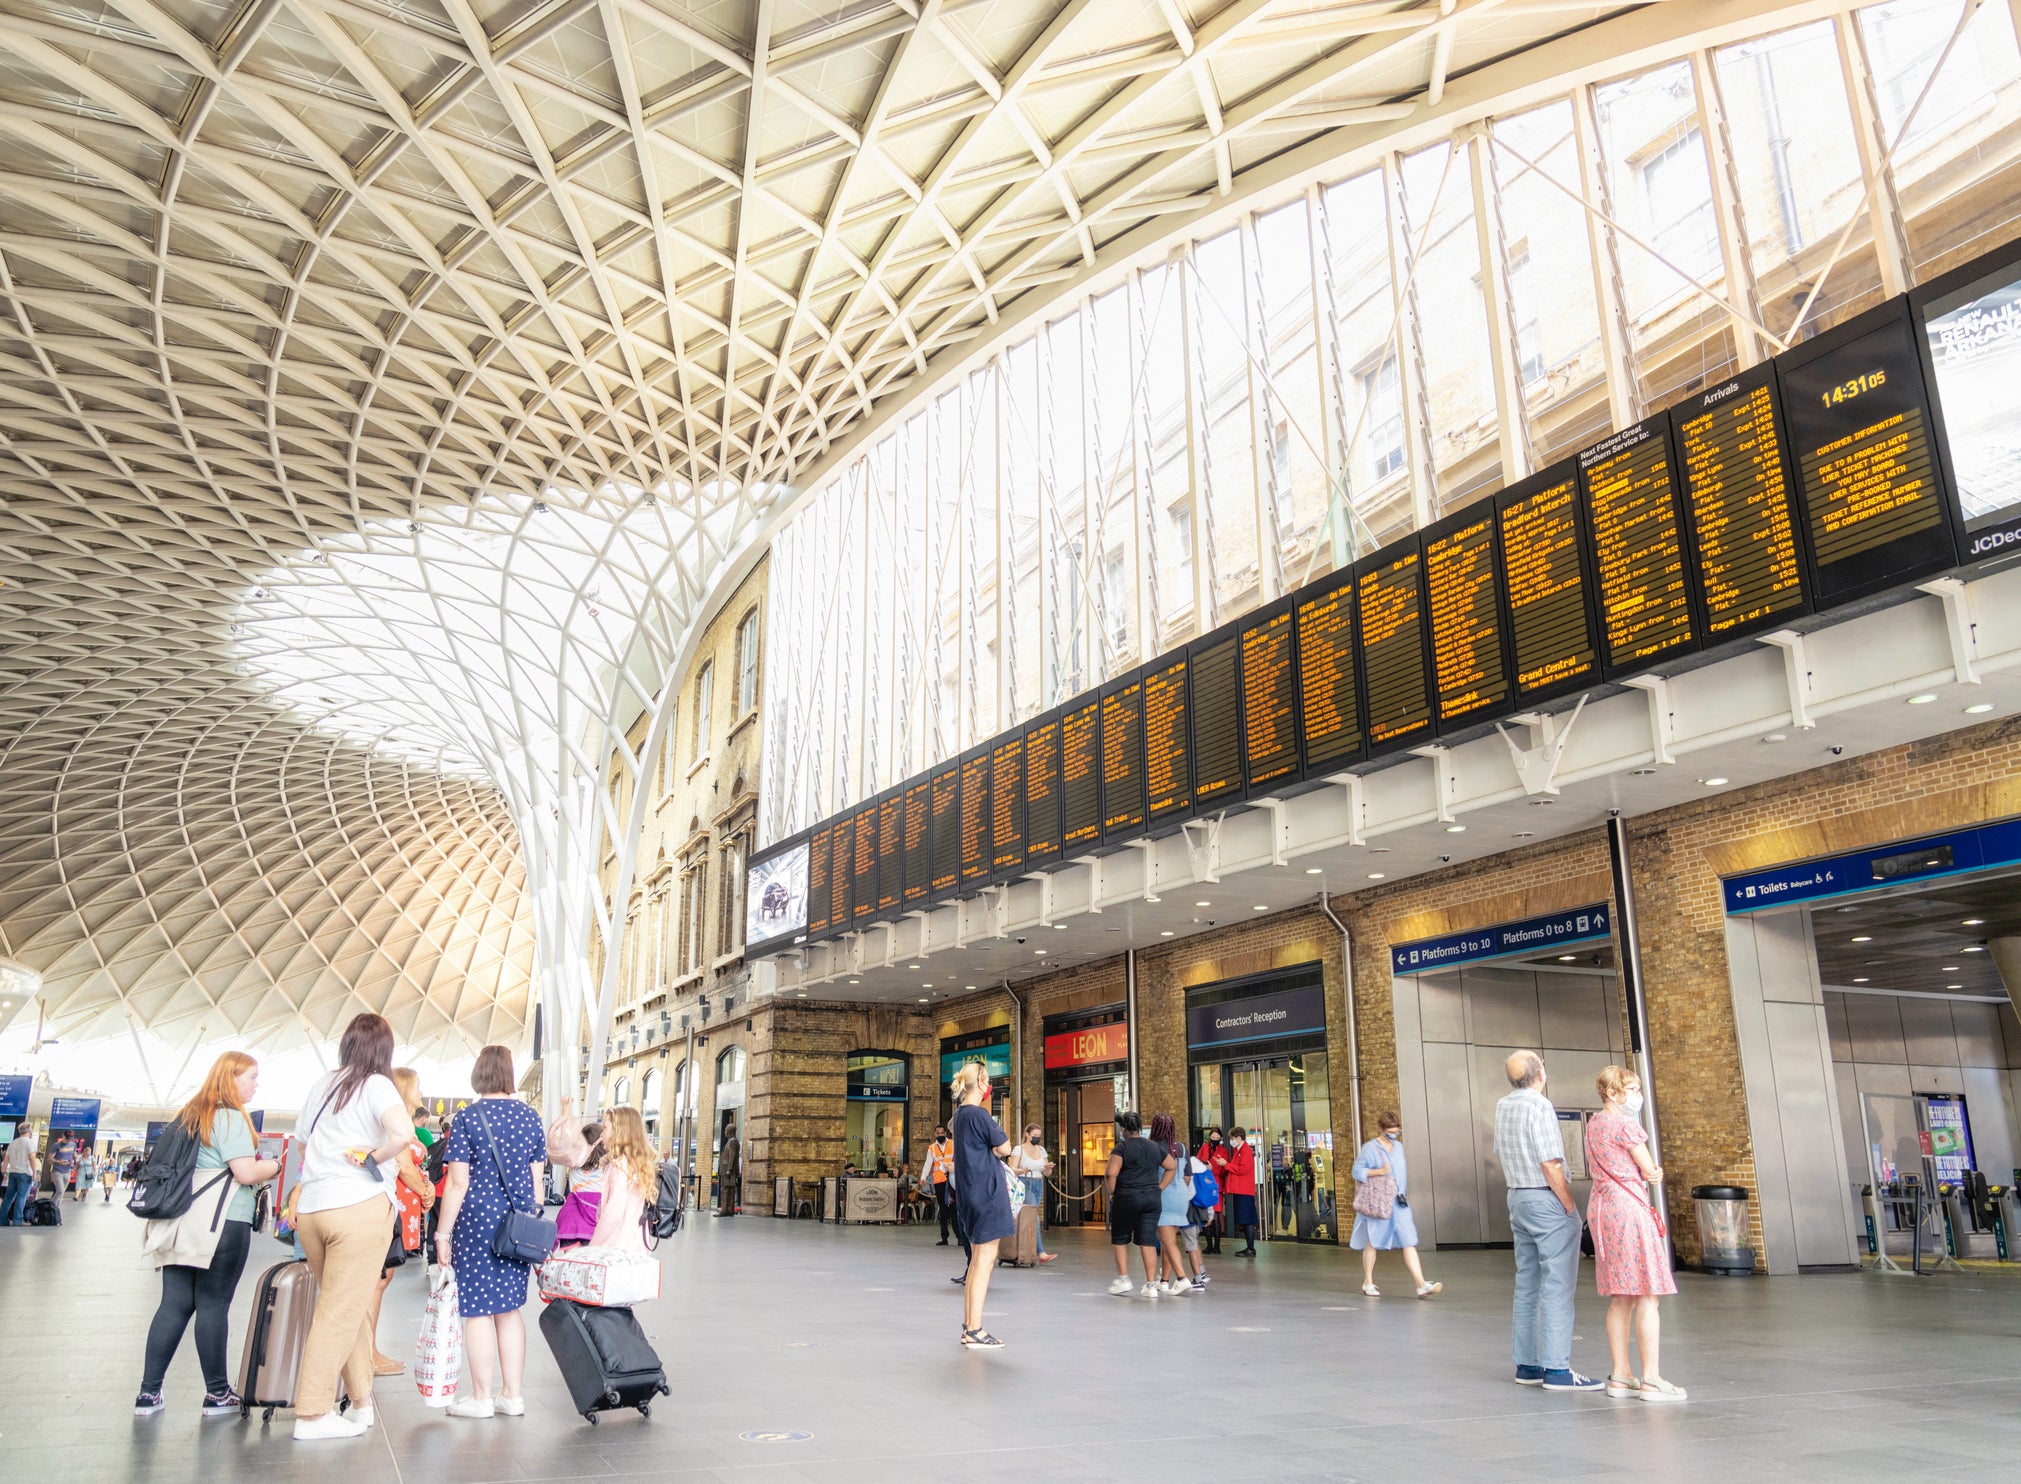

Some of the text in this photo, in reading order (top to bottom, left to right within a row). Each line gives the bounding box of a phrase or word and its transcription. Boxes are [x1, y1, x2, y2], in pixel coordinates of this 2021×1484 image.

[1704, 382, 1739, 406] Arrivals
[1733, 404, 1751, 417] Expt
[1682, 413, 1713, 432] Cambridge
[1736, 421, 1754, 434] Expt
[1580, 425, 1642, 460] Next Fastest Great
[1684, 436, 1700, 448] York
[1816, 414, 1903, 456] CUSTOMER INFORMATION
[1582, 431, 1650, 469] Northern Service to:
[1739, 439, 1757, 451] Expt
[1818, 432, 1909, 475] DUE TO A PROBLEM WITH
[1687, 446, 1720, 465] Harrogate
[1753, 449, 1779, 464] On time
[1842, 458, 1868, 475] TICKET
[1870, 443, 1908, 464] MACHINES
[1689, 470, 1706, 482] Kings
[1707, 463, 1724, 475] Lynn
[1755, 467, 1782, 482] On time
[1837, 458, 1895, 487] YOU MAY BOARD
[1849, 473, 1885, 493] SERVICES
[1886, 464, 1907, 479] WITH
[1531, 484, 1566, 506] Platform
[1691, 482, 1723, 499] Edinburgh
[1747, 492, 1765, 505] Expt
[1847, 481, 1892, 504] PRE-BOOKED
[1694, 500, 1724, 517] Aberdeen
[1761, 503, 1788, 518] On time
[1822, 479, 1922, 523] TICKET REFERENCE NUMBER
[1503, 494, 1571, 531] Bradford Interch
[1826, 521, 1840, 532] AND
[1841, 500, 1895, 526] CONFIRMATION
[1453, 523, 1485, 543] Platform
[1696, 517, 1729, 534] Cambridge
[1753, 528, 1771, 540] Expt
[1427, 544, 1463, 566] Cambridge
[1699, 539, 1719, 552] Leeds
[1767, 540, 1793, 554] On time
[1393, 561, 1403, 571] On
[1403, 554, 1418, 566] time
[1701, 560, 1713, 569] Ely
[1770, 558, 1796, 573] On time
[1359, 583, 1379, 597] Leeds
[1704, 576, 1718, 587] Hull
[1772, 577, 1799, 591] On time
[1707, 589, 1739, 604] Cambridge
[1309, 602, 1338, 620] Edinburgh
[1710, 605, 1771, 632] Page 1 of 1
[1518, 655, 1576, 683] Grand Central
[1441, 691, 1478, 710] Thameslink
[1758, 878, 1813, 895] Toilets Babycare
[1503, 921, 1573, 945] Platforms 0 to 8
[1421, 938, 1491, 961] Platforms 9 to 10
[1215, 1009, 1287, 1029] Contractors' Reception
[1073, 1032, 1107, 1060] LEON
